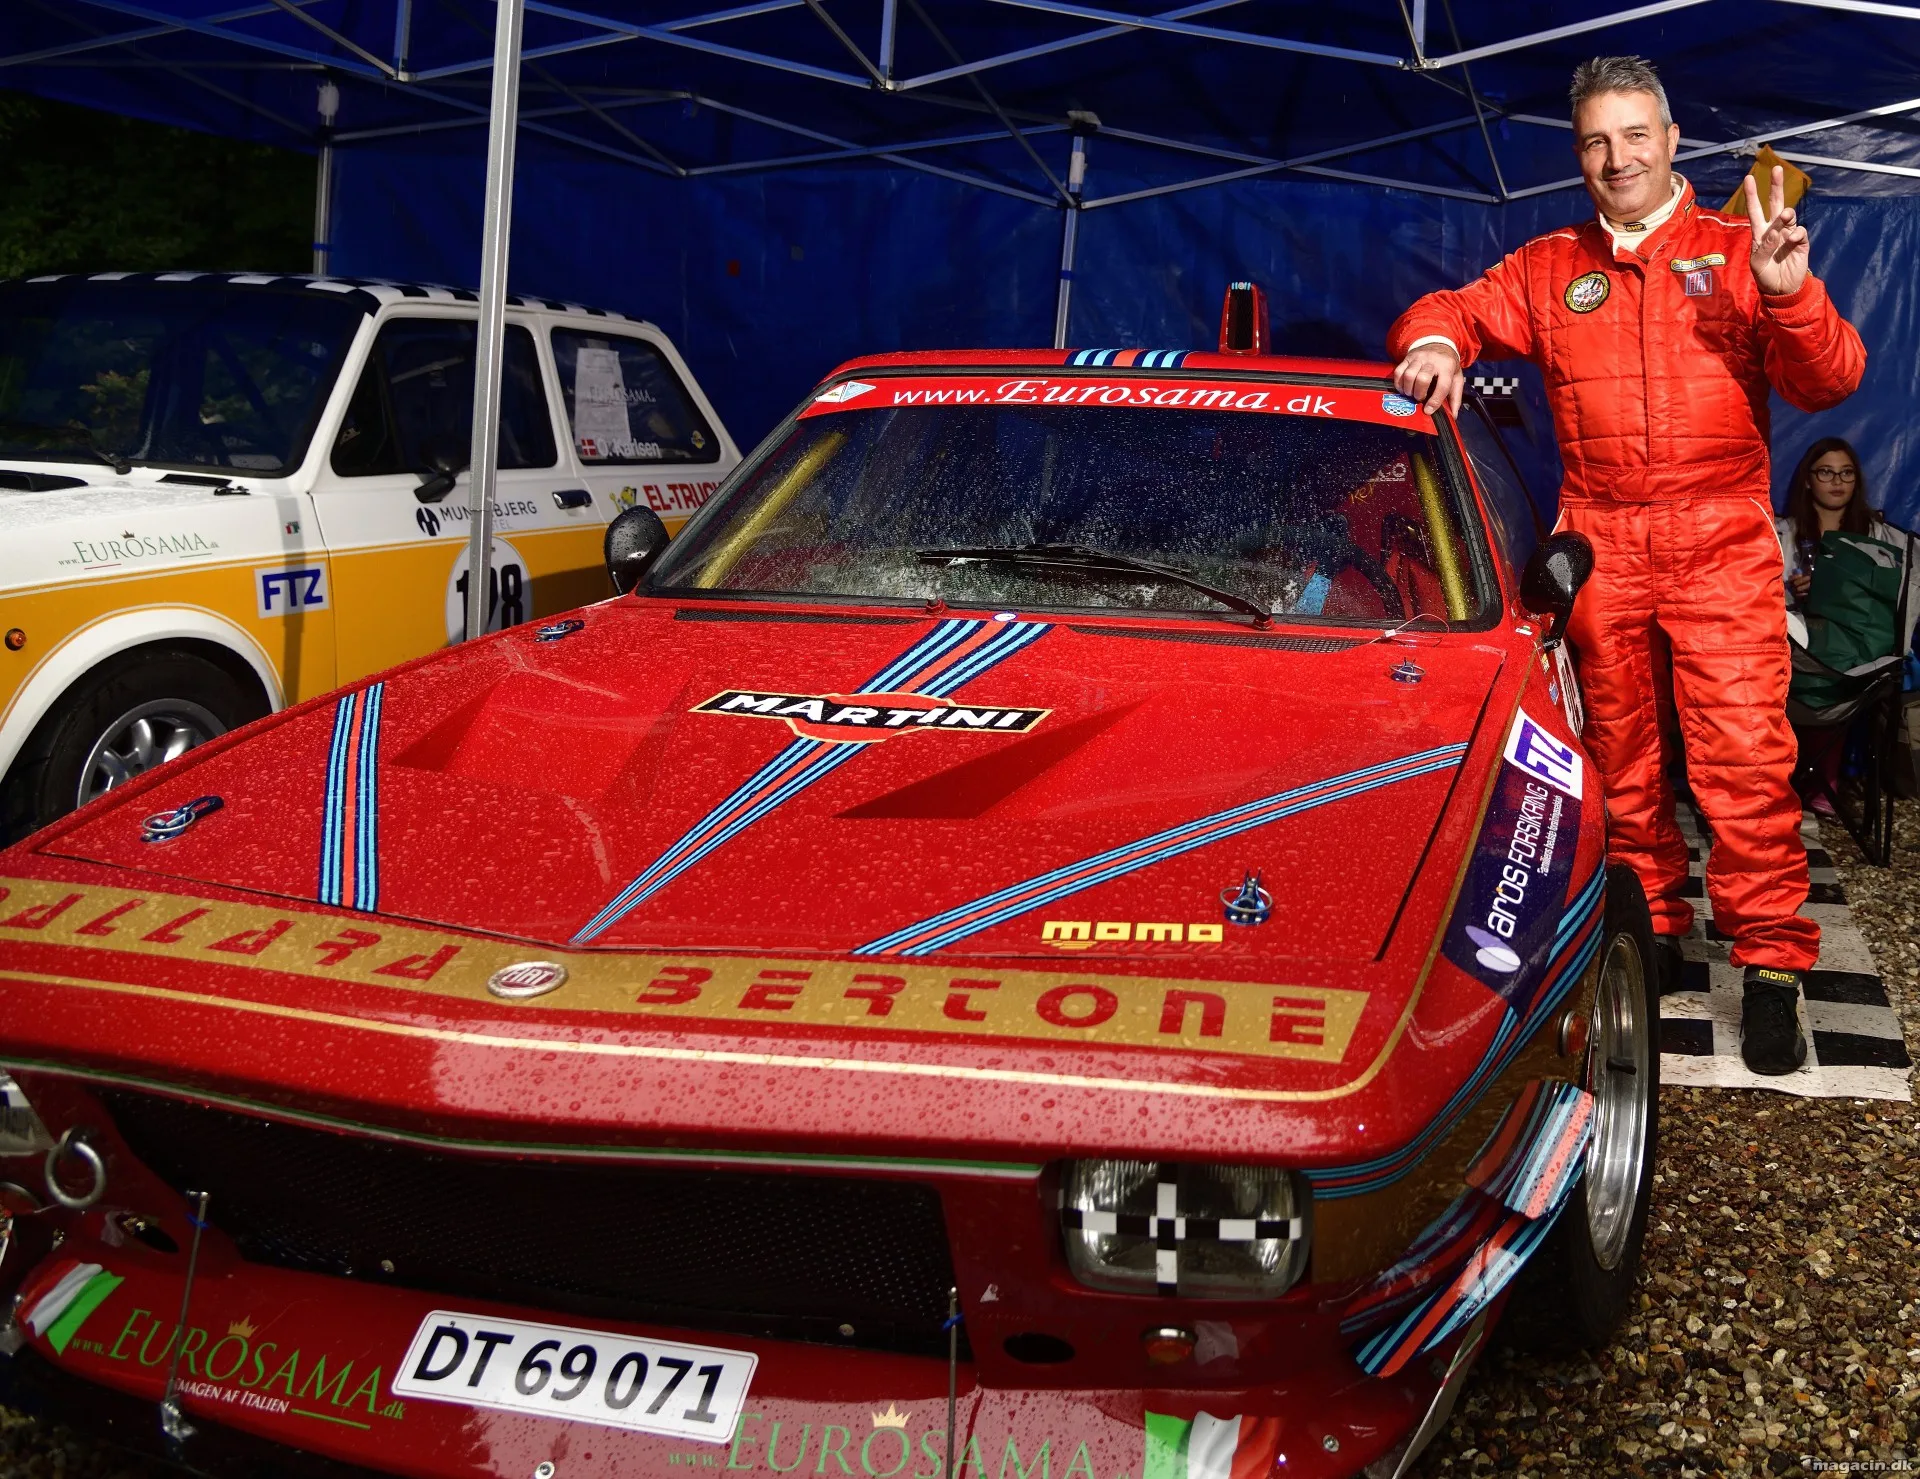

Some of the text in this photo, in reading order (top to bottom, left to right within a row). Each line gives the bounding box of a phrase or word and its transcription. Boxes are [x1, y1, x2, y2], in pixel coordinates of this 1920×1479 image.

[893, 379, 1337, 416] www.Eurosama.dk
[440, 501, 538, 521] MUNBJERG
[58, 532, 219, 566] www.EUROSAMA.dk
[262, 569, 323, 611] FTZ
[719, 695, 1024, 728] MARTINI
[1514, 718, 1573, 790] FTZ
[1507, 782, 1549, 869] FORSIKRING
[1041, 921, 1223, 942] momo
[0, 887, 1326, 1046] ALLARA BERTONE
[501, 966, 554, 986] FIAT
[71, 1308, 407, 1421] www.EUROSAMA.dk
[413, 1325, 725, 1424] DT 69 071
[668, 1413, 1130, 1479] www.EUROSAMA
